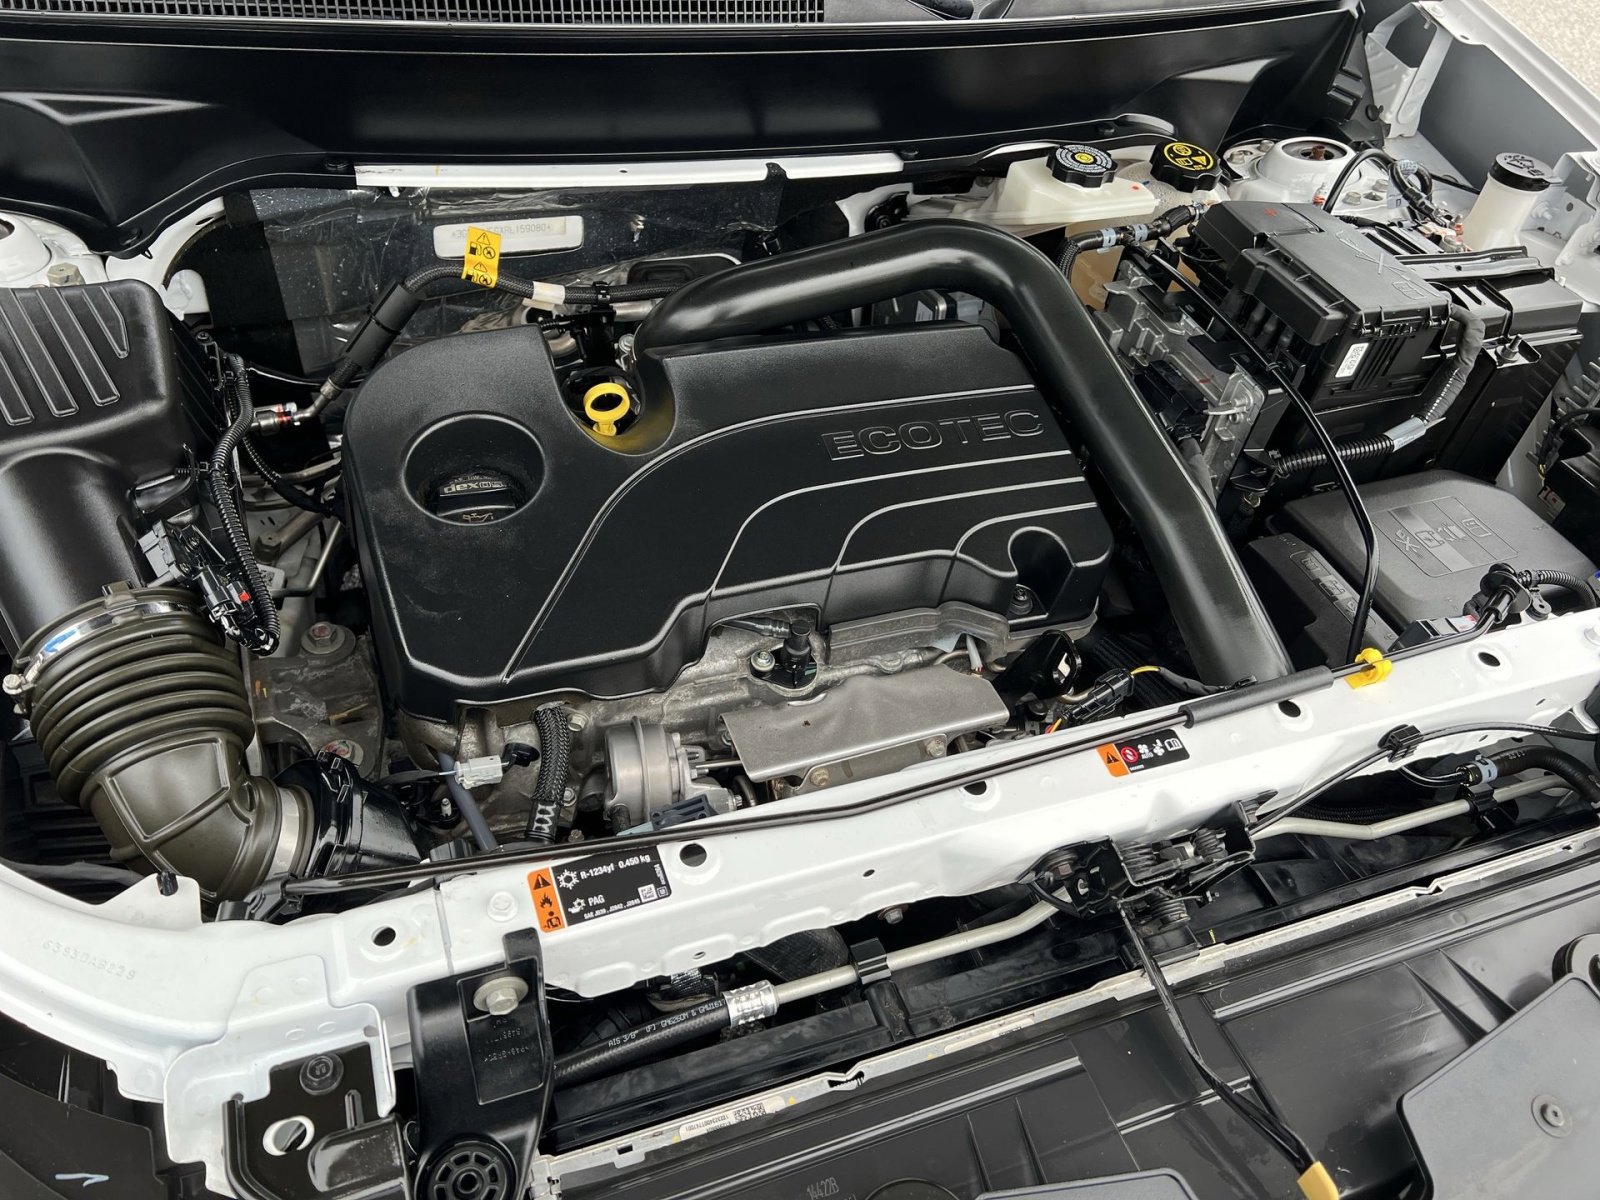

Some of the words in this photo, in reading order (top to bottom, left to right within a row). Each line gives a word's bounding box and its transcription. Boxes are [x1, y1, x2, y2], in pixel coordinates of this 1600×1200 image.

[821, 409, 1044, 460] ECOTEC
[580, 863, 615, 879] R-1234yf
[618, 857, 639, 869] 0.450
[640, 854, 651, 864] kg
[588, 894, 605, 906] PAG
